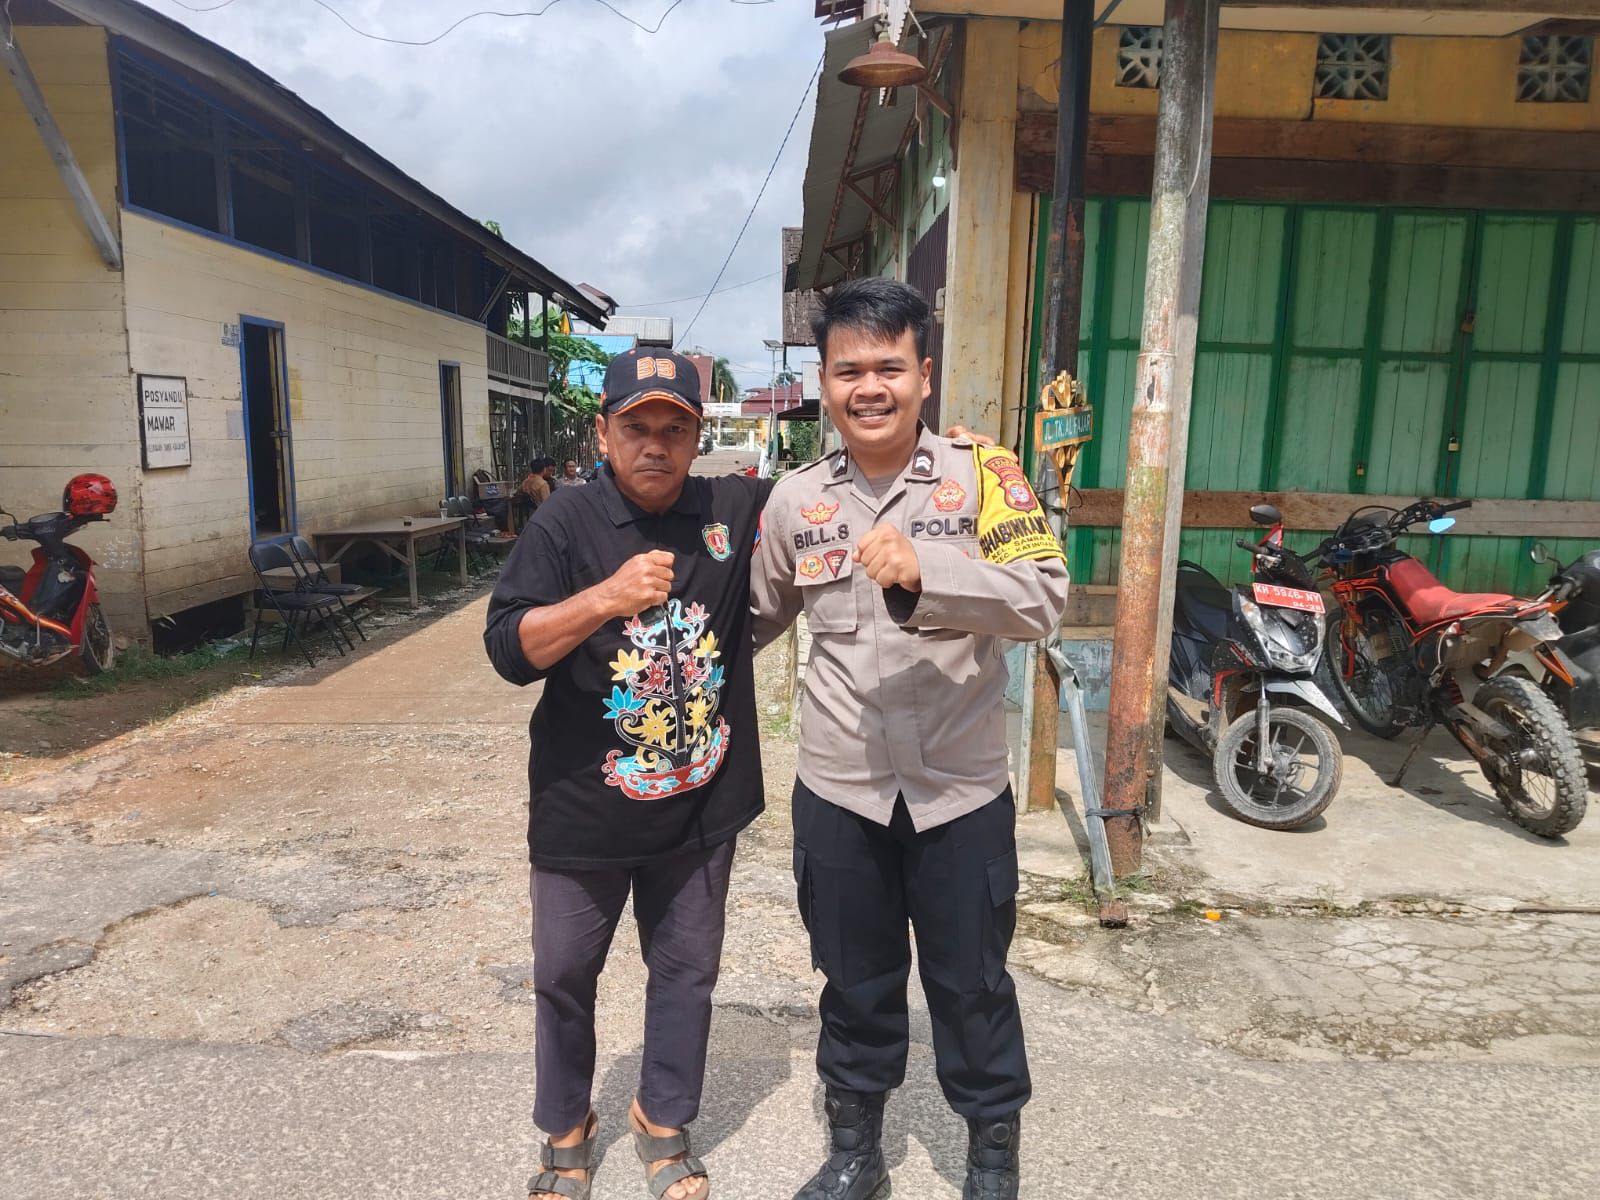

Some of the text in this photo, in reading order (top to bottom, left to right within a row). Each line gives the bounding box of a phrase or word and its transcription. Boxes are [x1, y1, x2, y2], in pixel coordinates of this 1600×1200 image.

[144, 390, 183, 403] POSYANDU
[147, 415, 176, 432] MAWAR
[911, 517, 978, 538] POLRI
